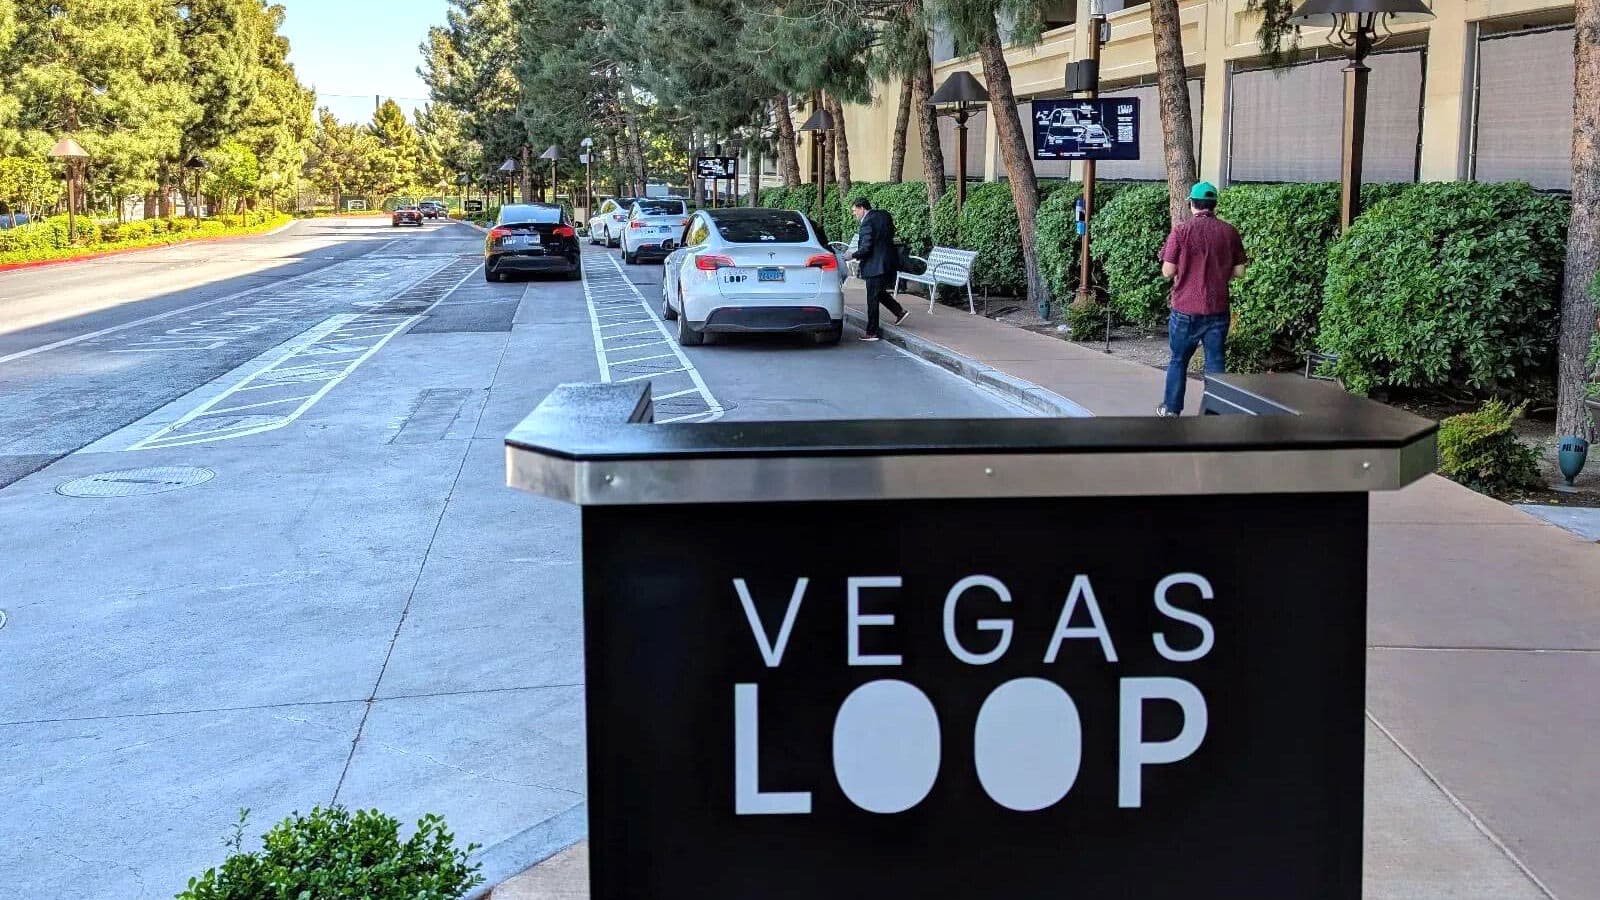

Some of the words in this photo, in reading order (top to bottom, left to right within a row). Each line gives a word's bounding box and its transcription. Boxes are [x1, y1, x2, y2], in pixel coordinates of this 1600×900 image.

[724, 275, 748, 284] LOOP
[733, 573, 1215, 668] VEGAS
[734, 677, 1209, 815] LOOP
